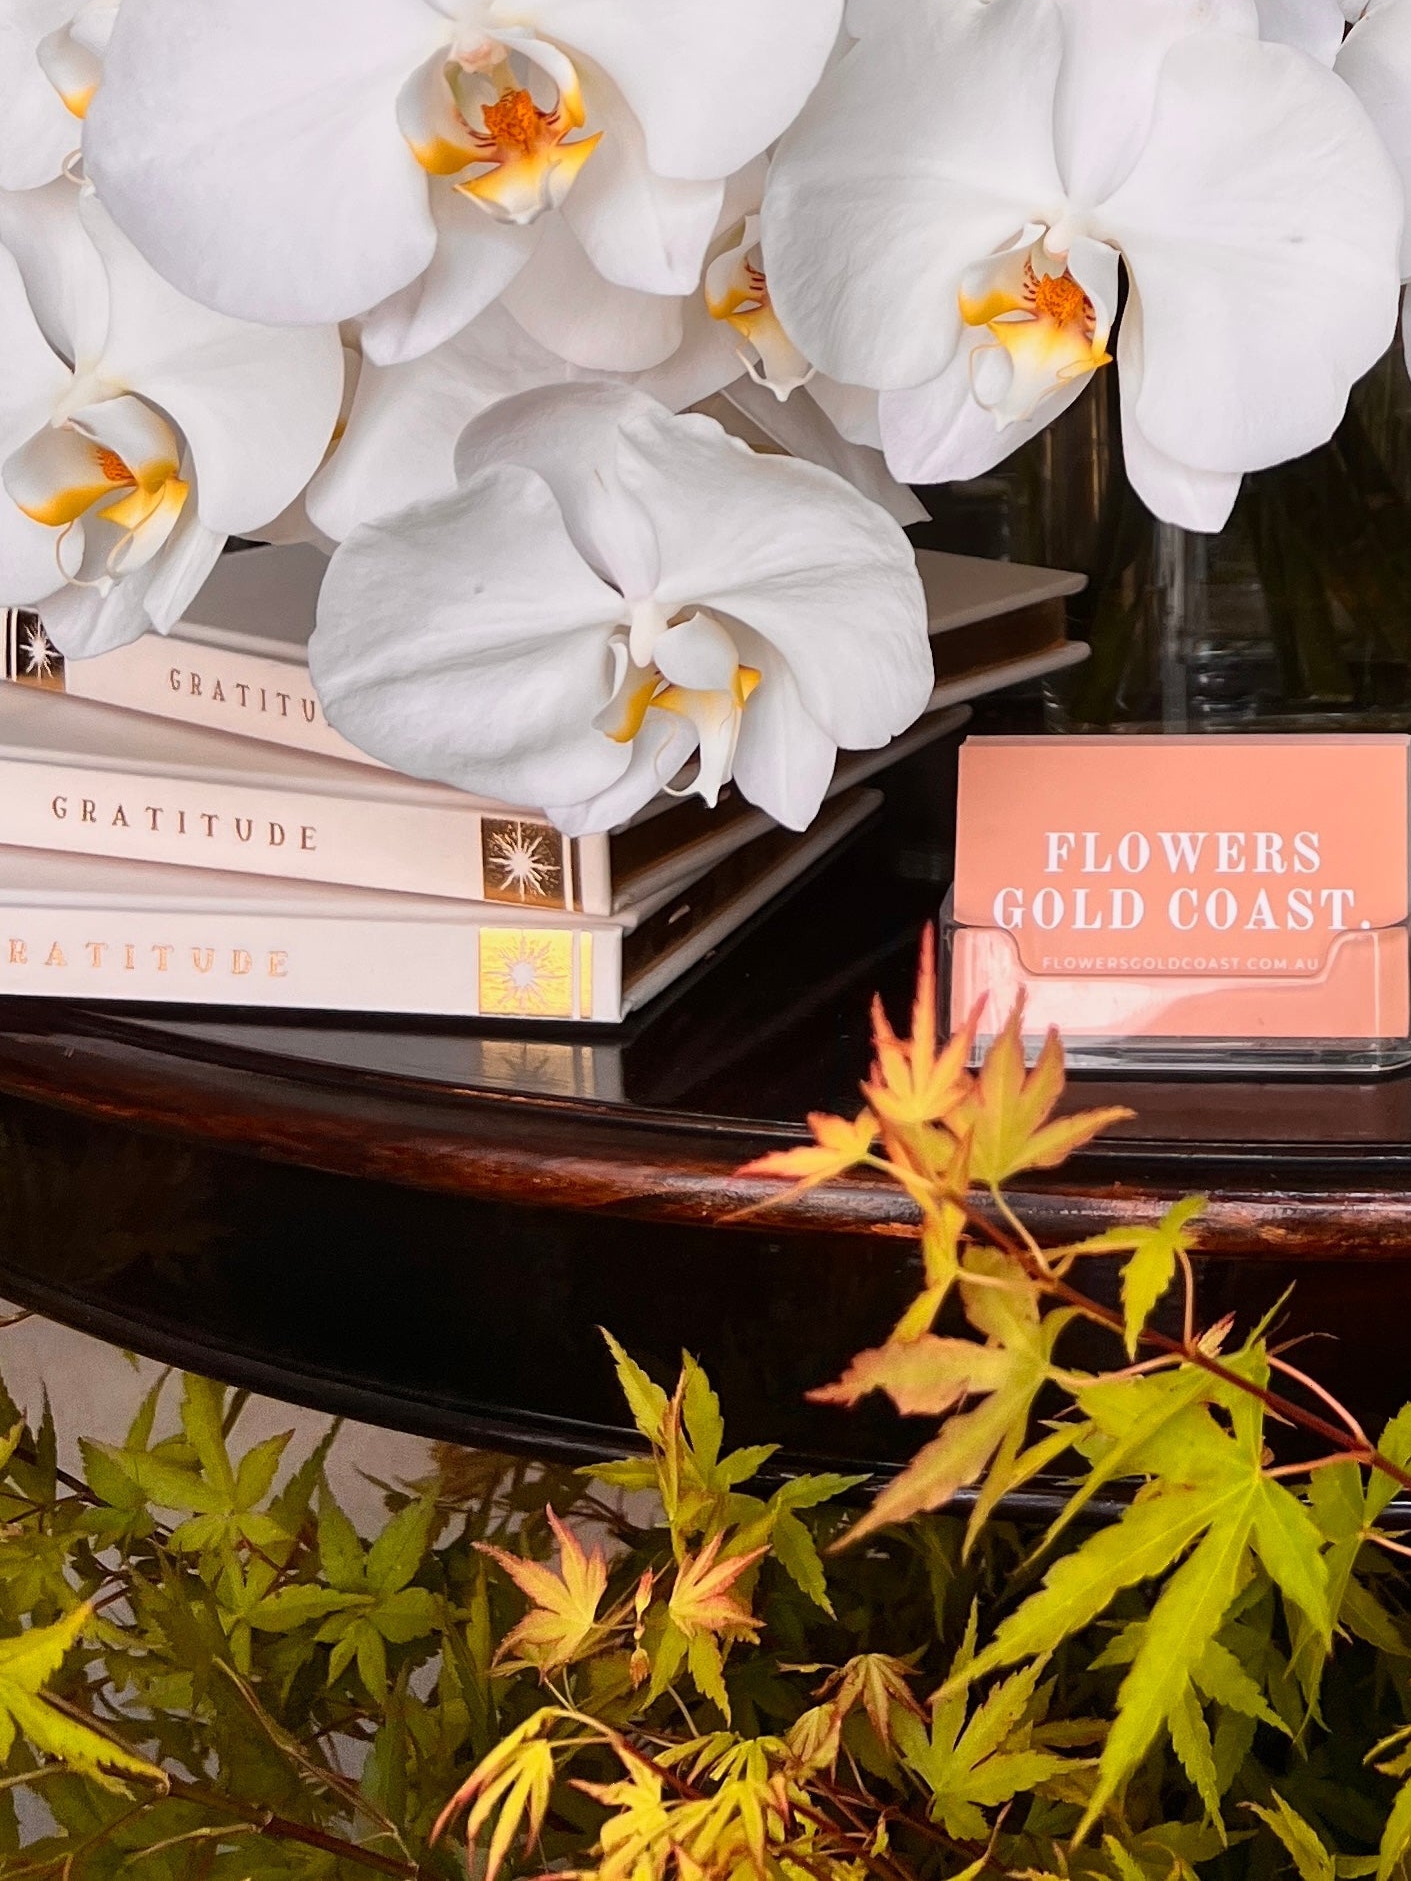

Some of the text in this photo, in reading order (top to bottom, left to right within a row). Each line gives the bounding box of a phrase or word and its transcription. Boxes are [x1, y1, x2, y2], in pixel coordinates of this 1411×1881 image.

[169, 668, 316, 723] GRATITU
[51, 795, 318, 851] GRATITUDE
[1044, 831, 1322, 874] FLOWERS
[993, 887, 1372, 931] GOLD COAST.
[8, 937, 289, 978] RATITUDE
